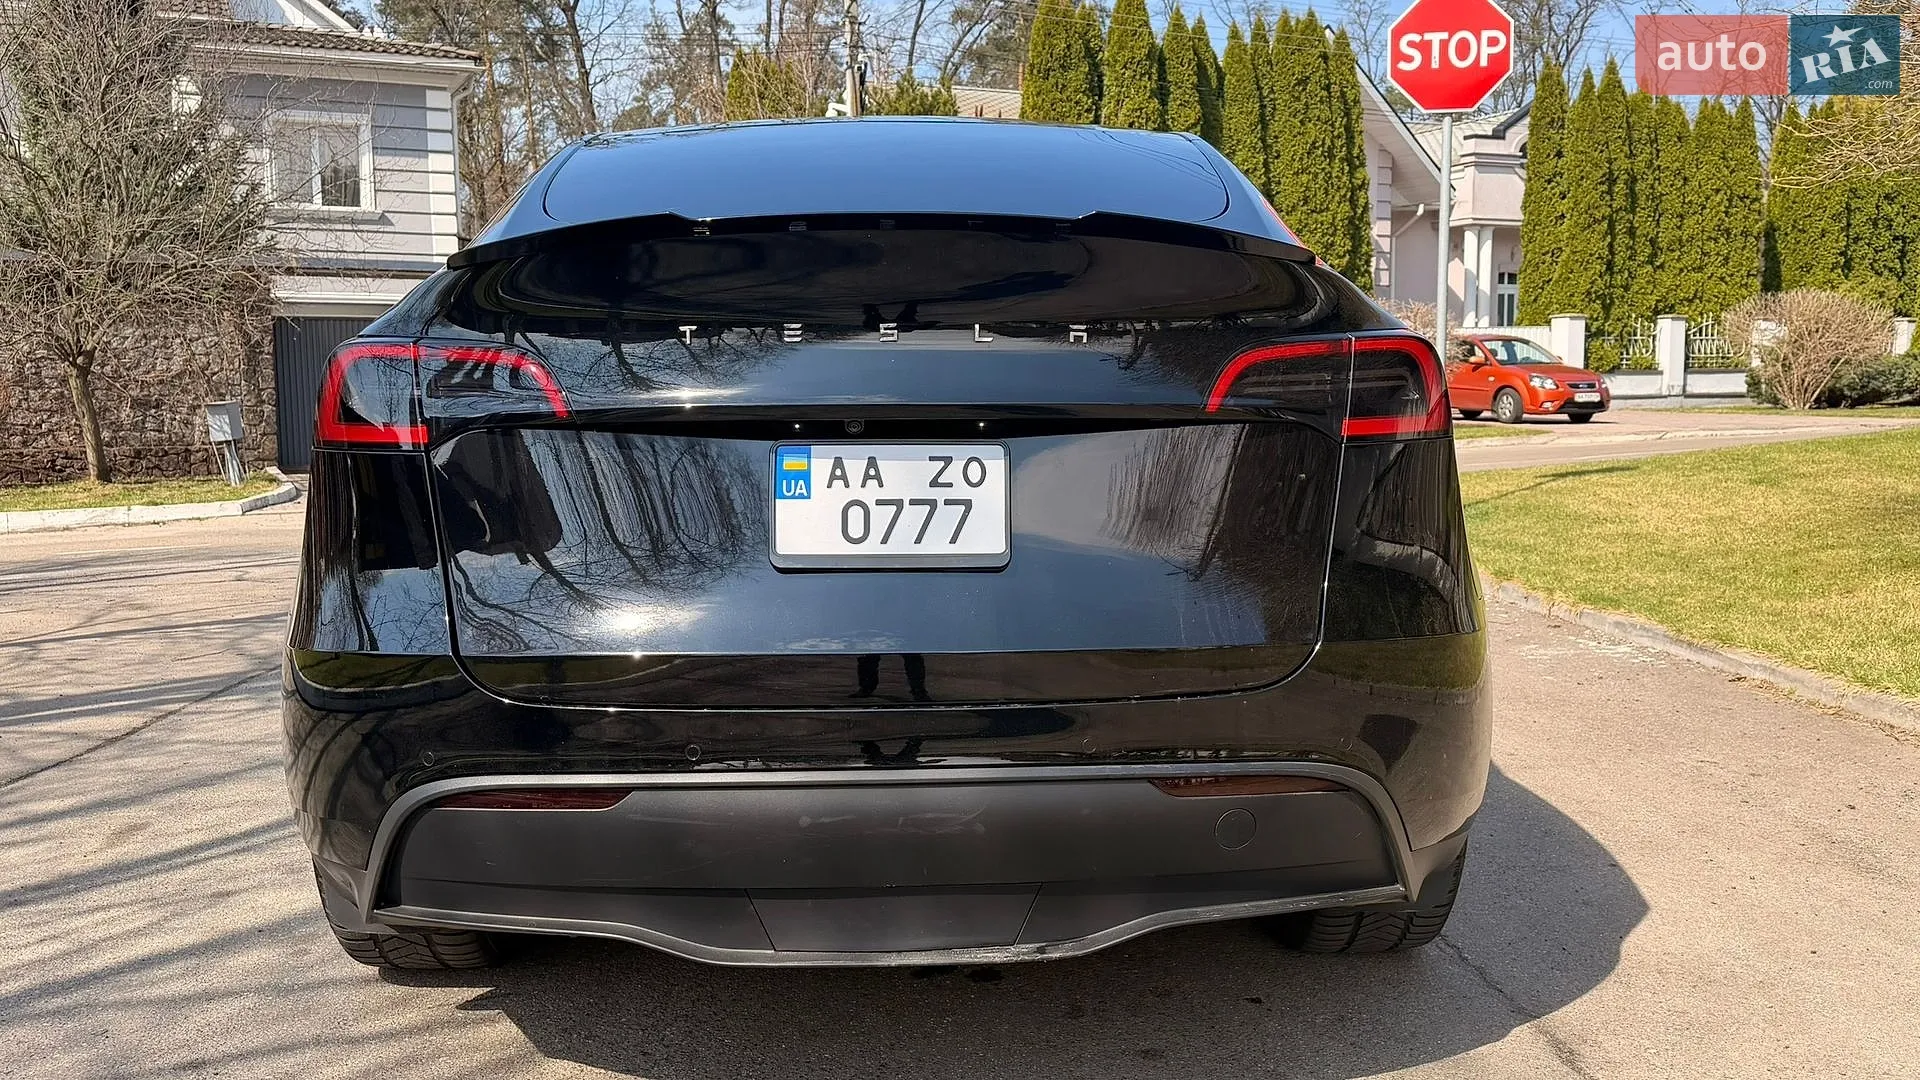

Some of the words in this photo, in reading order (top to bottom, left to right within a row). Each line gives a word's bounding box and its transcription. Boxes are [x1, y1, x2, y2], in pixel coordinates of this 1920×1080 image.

[1396, 29, 1507, 71] STOP
[678, 323, 1088, 343] TESLA
[782, 479, 808, 496] UA
[827, 456, 884, 488] AA
[928, 455, 986, 488] ZO
[841, 498, 973, 545] 0777
